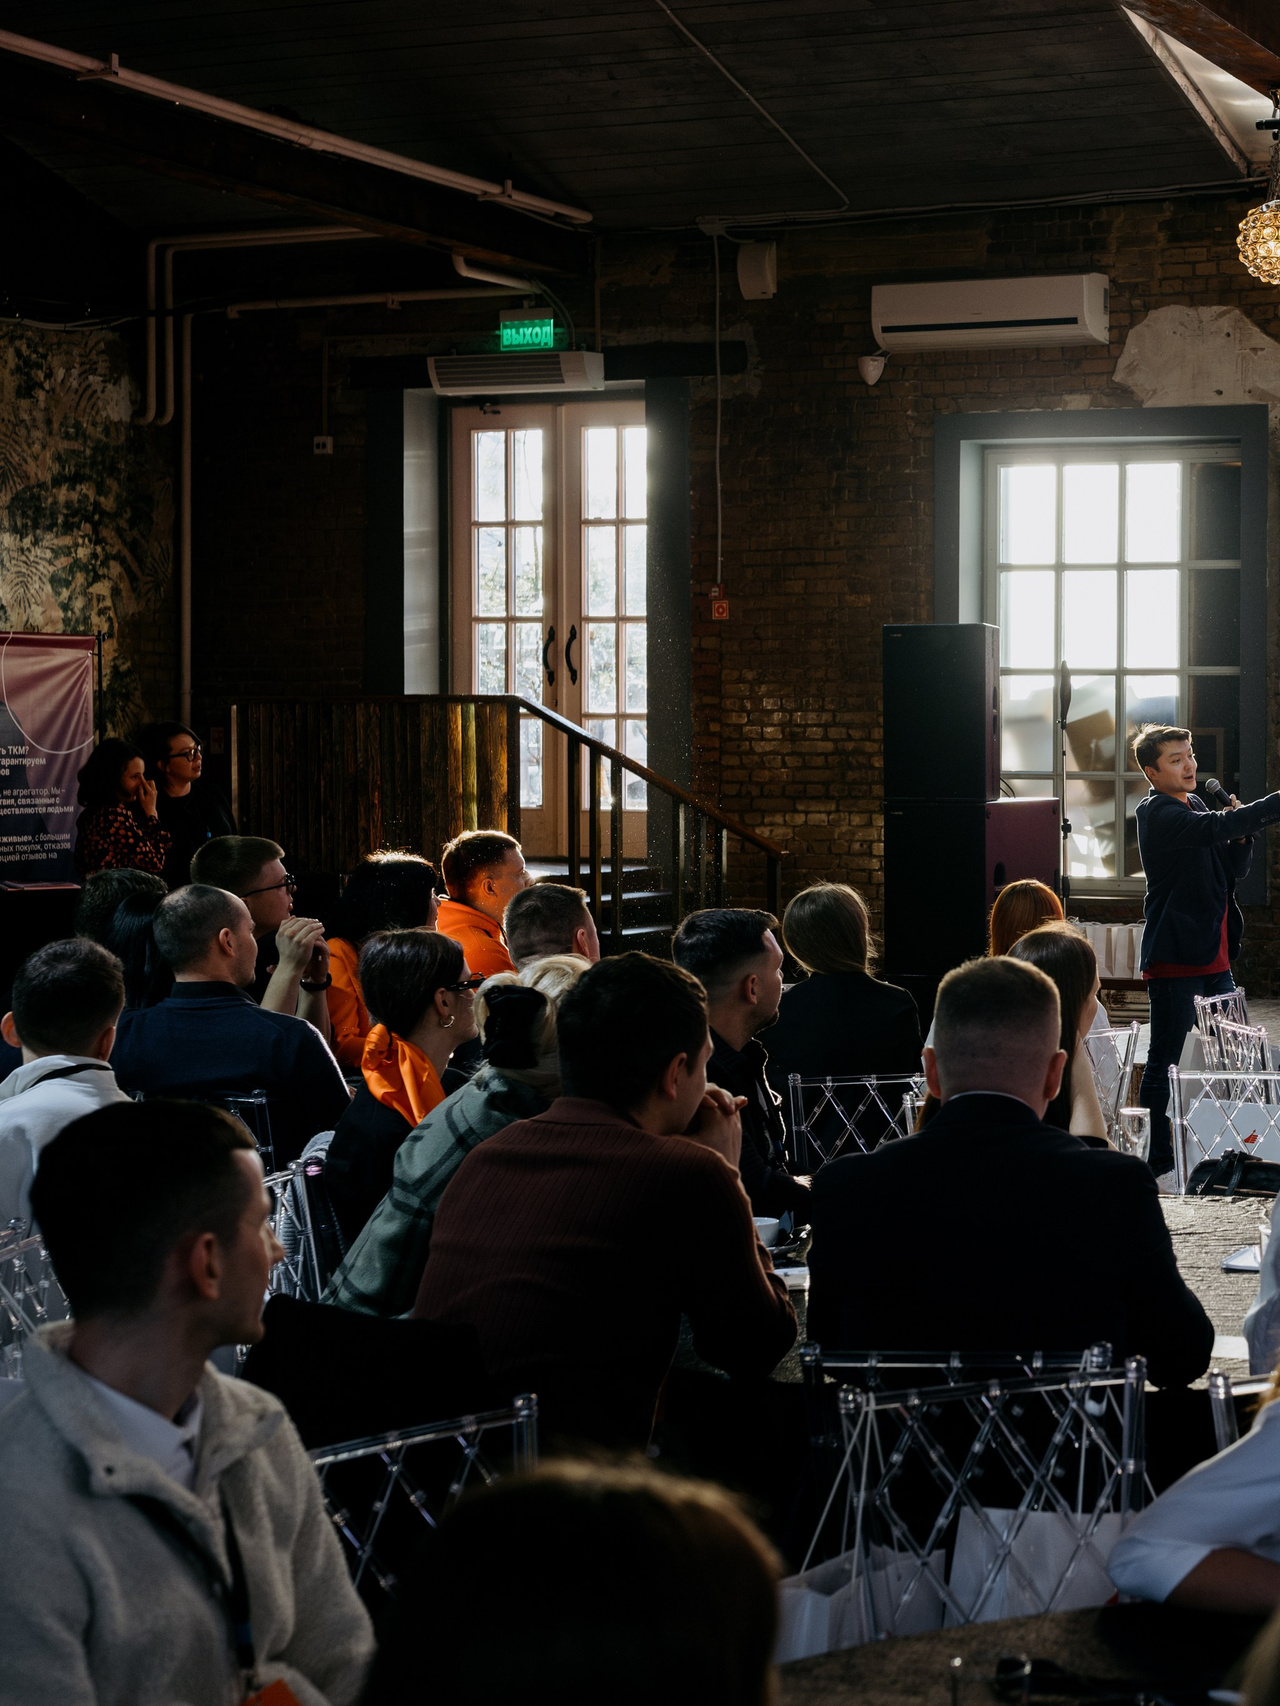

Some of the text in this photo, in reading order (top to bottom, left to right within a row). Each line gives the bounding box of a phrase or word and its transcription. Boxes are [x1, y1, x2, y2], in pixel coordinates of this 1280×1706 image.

[503, 326, 551, 346] ВЫХОД
[7, 745, 30, 755] ТКМ?
[0, 757, 46, 767] арантируем
[0, 768, 10, 776] ов
[0, 852, 20, 863] цией
